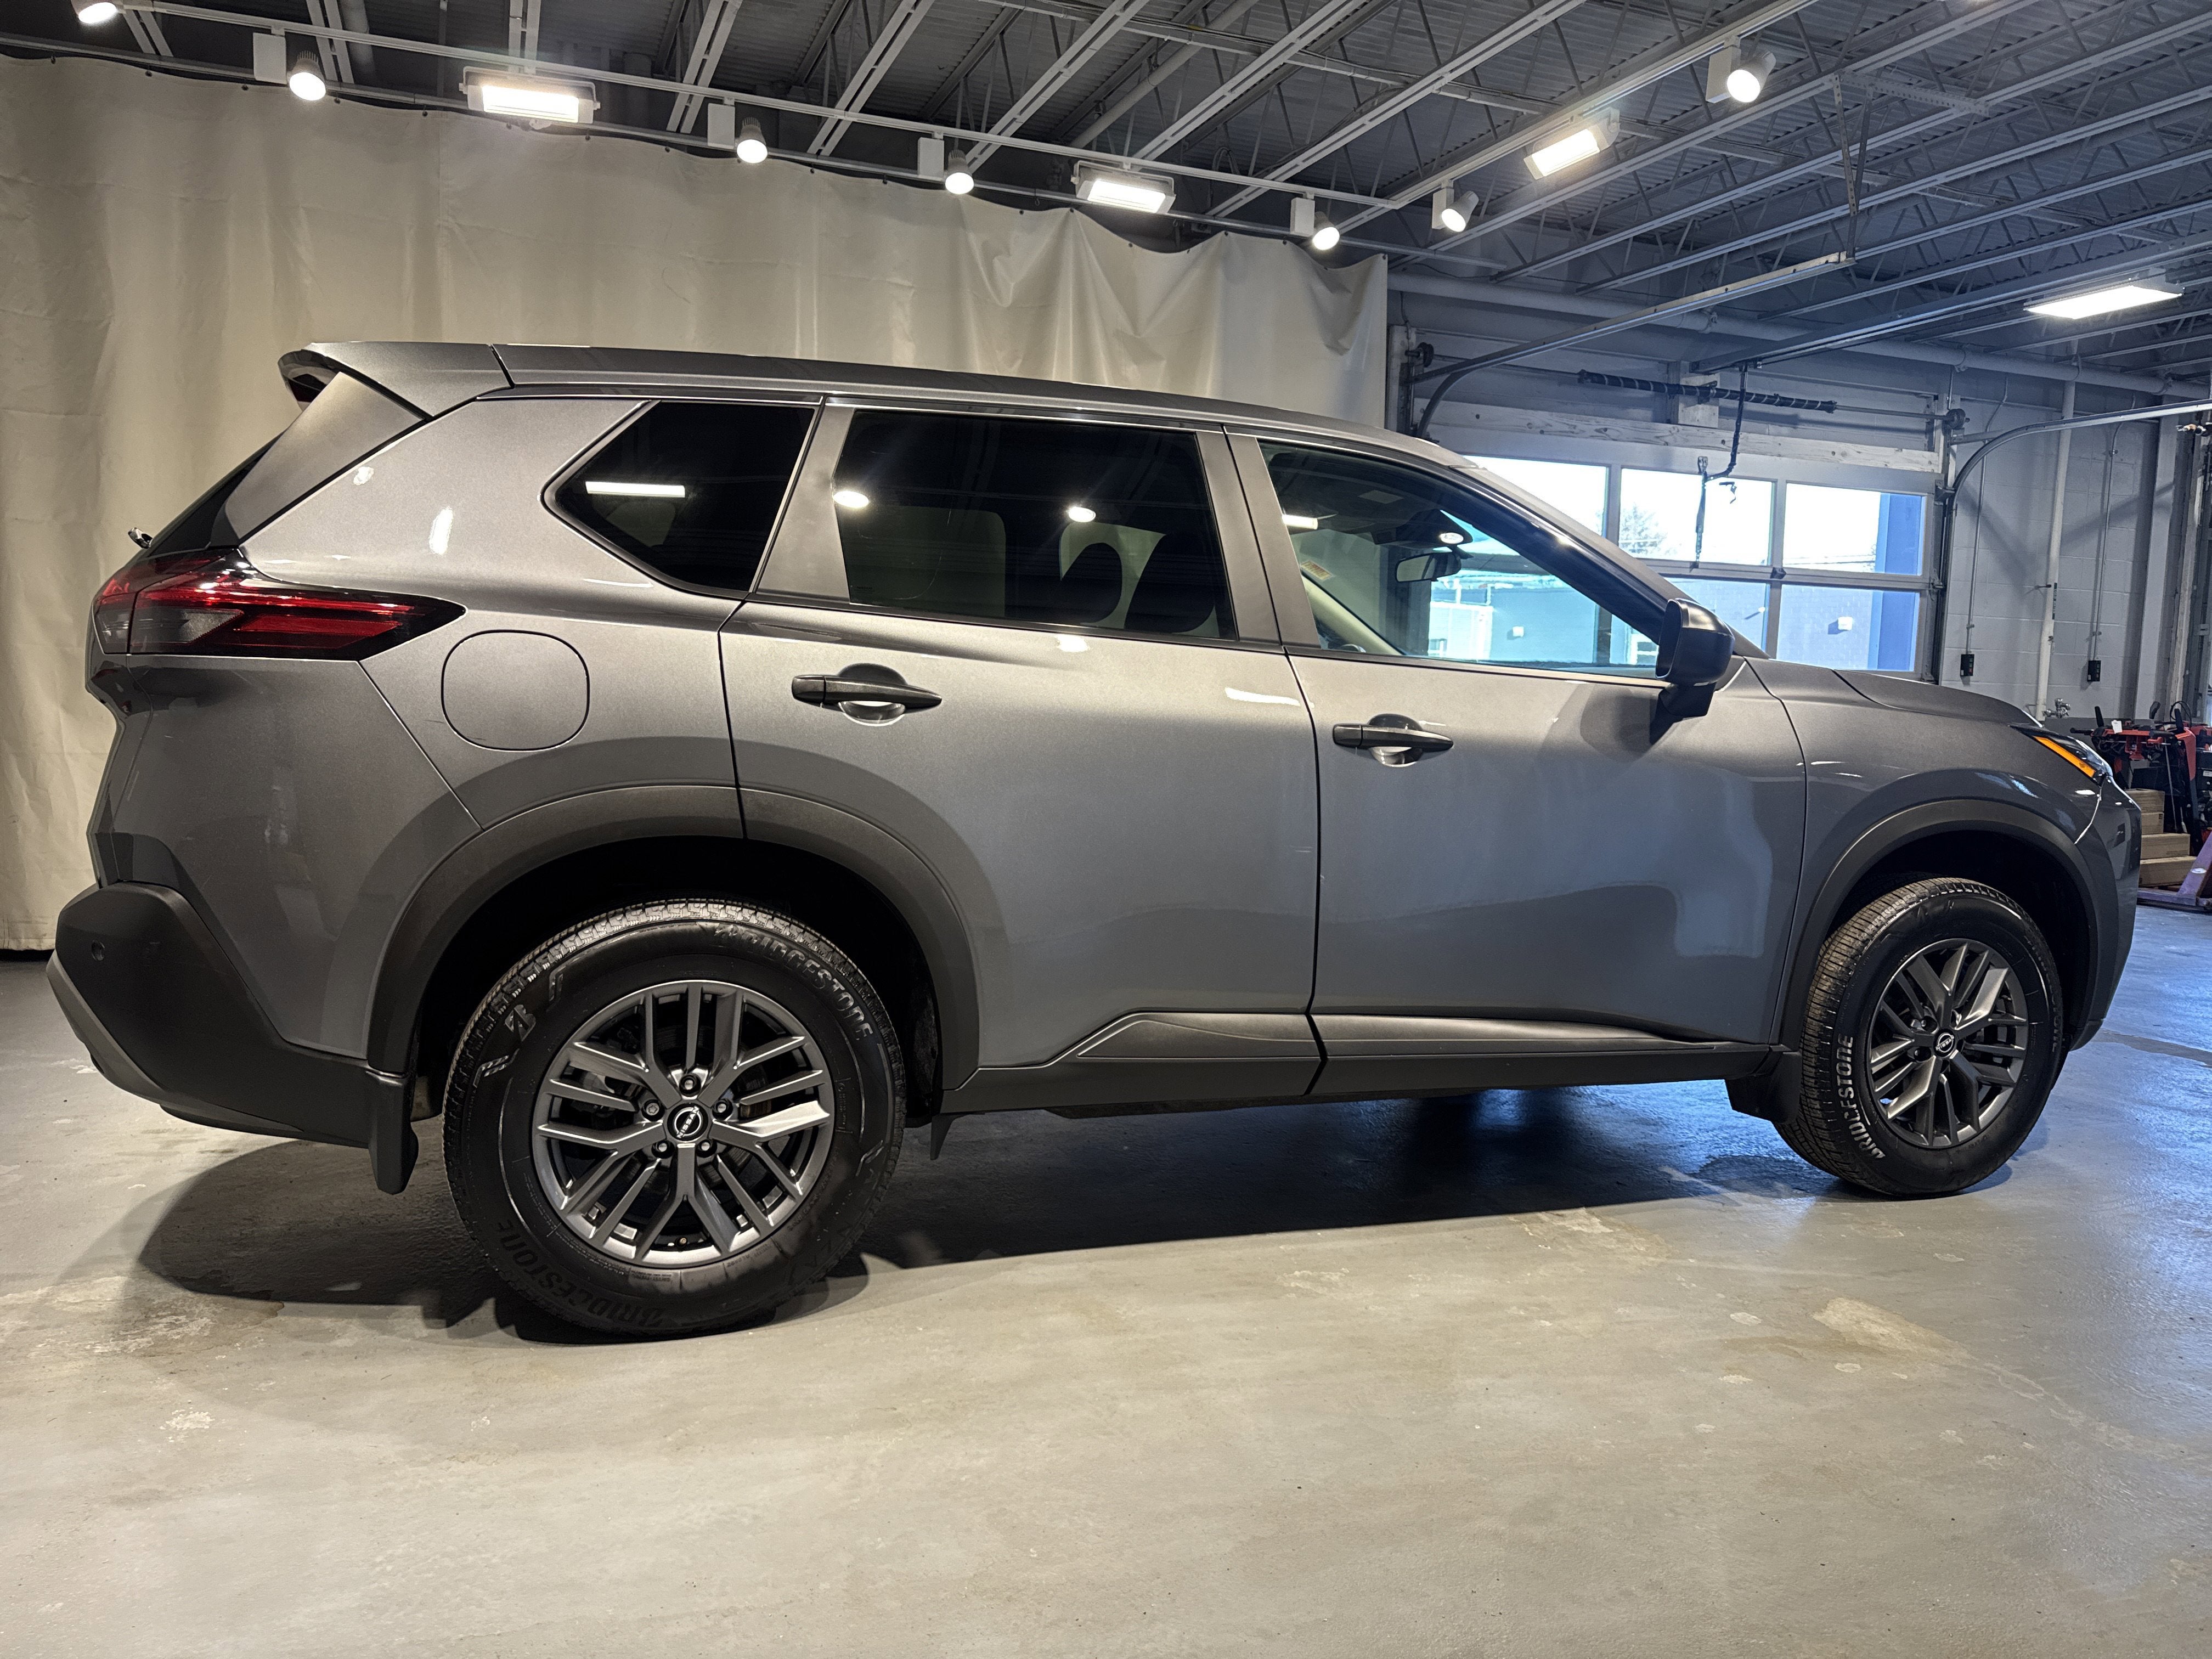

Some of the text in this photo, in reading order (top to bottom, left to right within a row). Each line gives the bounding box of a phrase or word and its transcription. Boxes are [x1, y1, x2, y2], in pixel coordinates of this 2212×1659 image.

[713, 924, 873, 1041] BRIDGESTONE
[676, 1105, 699, 1138] NISSAN
[1836, 1034, 1886, 1159] BRIDGESTONE
